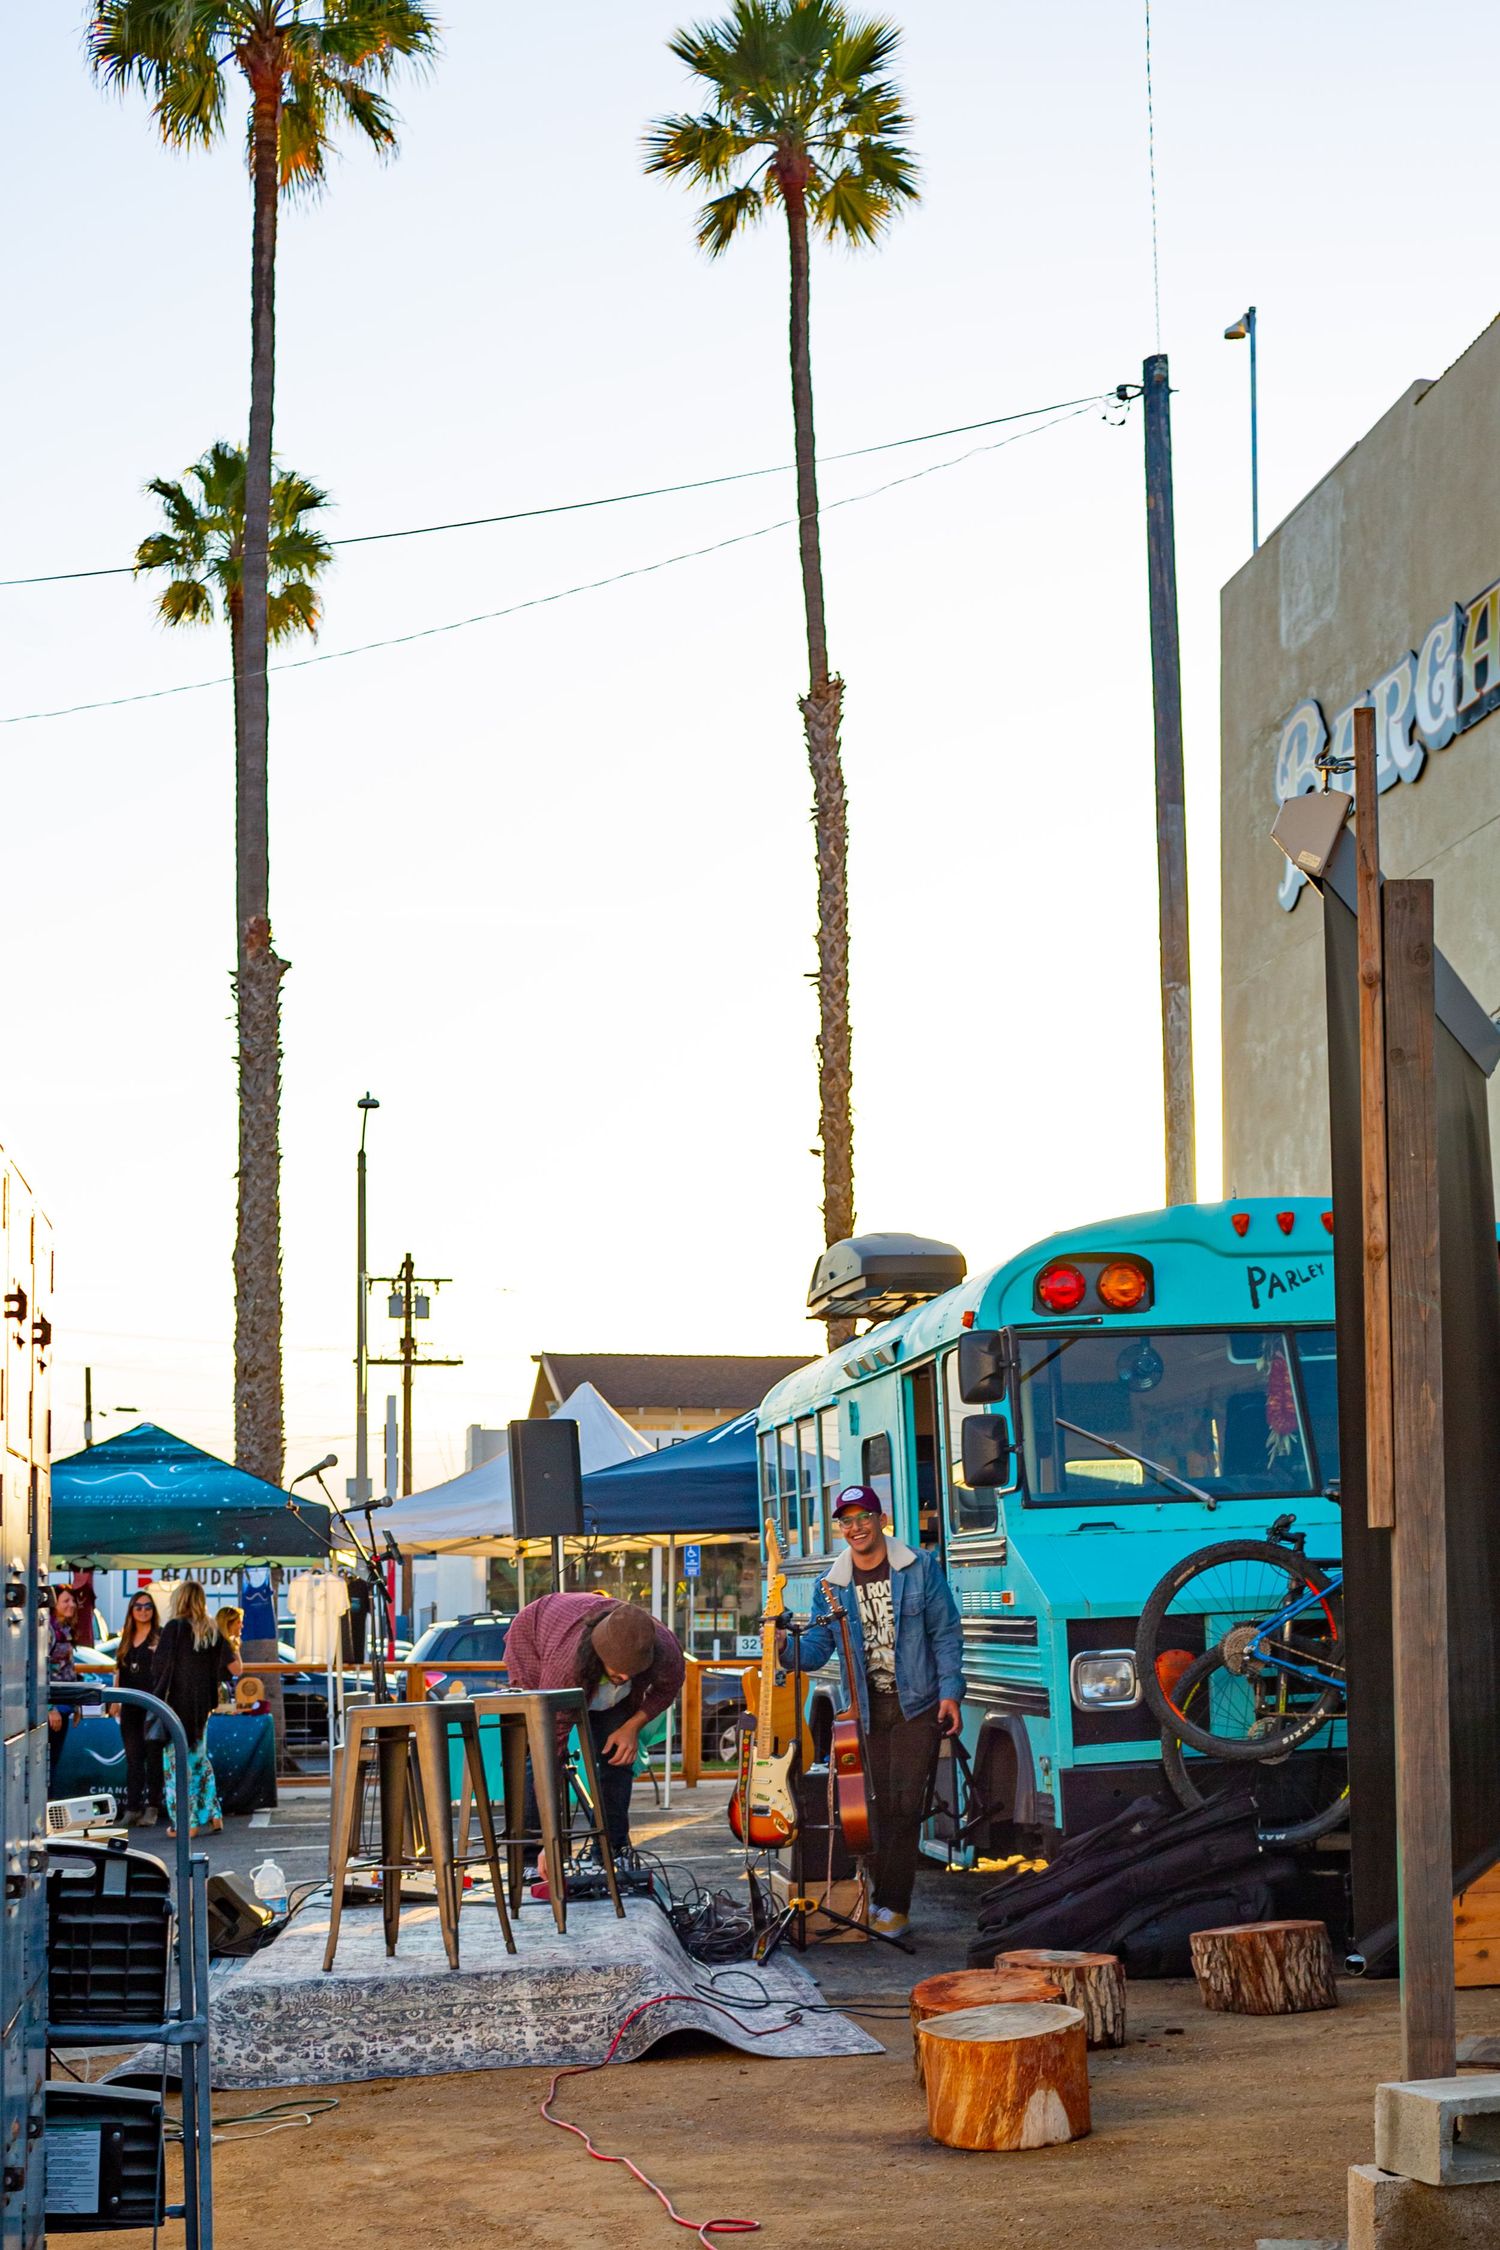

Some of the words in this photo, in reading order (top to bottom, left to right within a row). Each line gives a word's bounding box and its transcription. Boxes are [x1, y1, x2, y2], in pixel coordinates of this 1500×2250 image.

[1247, 1263, 1324, 1310] PARLEY
[161, 1569, 234, 1585] BEAUDR
[741, 1638, 762, 1650] 32
[89, 1786, 128, 1794] CHANG
